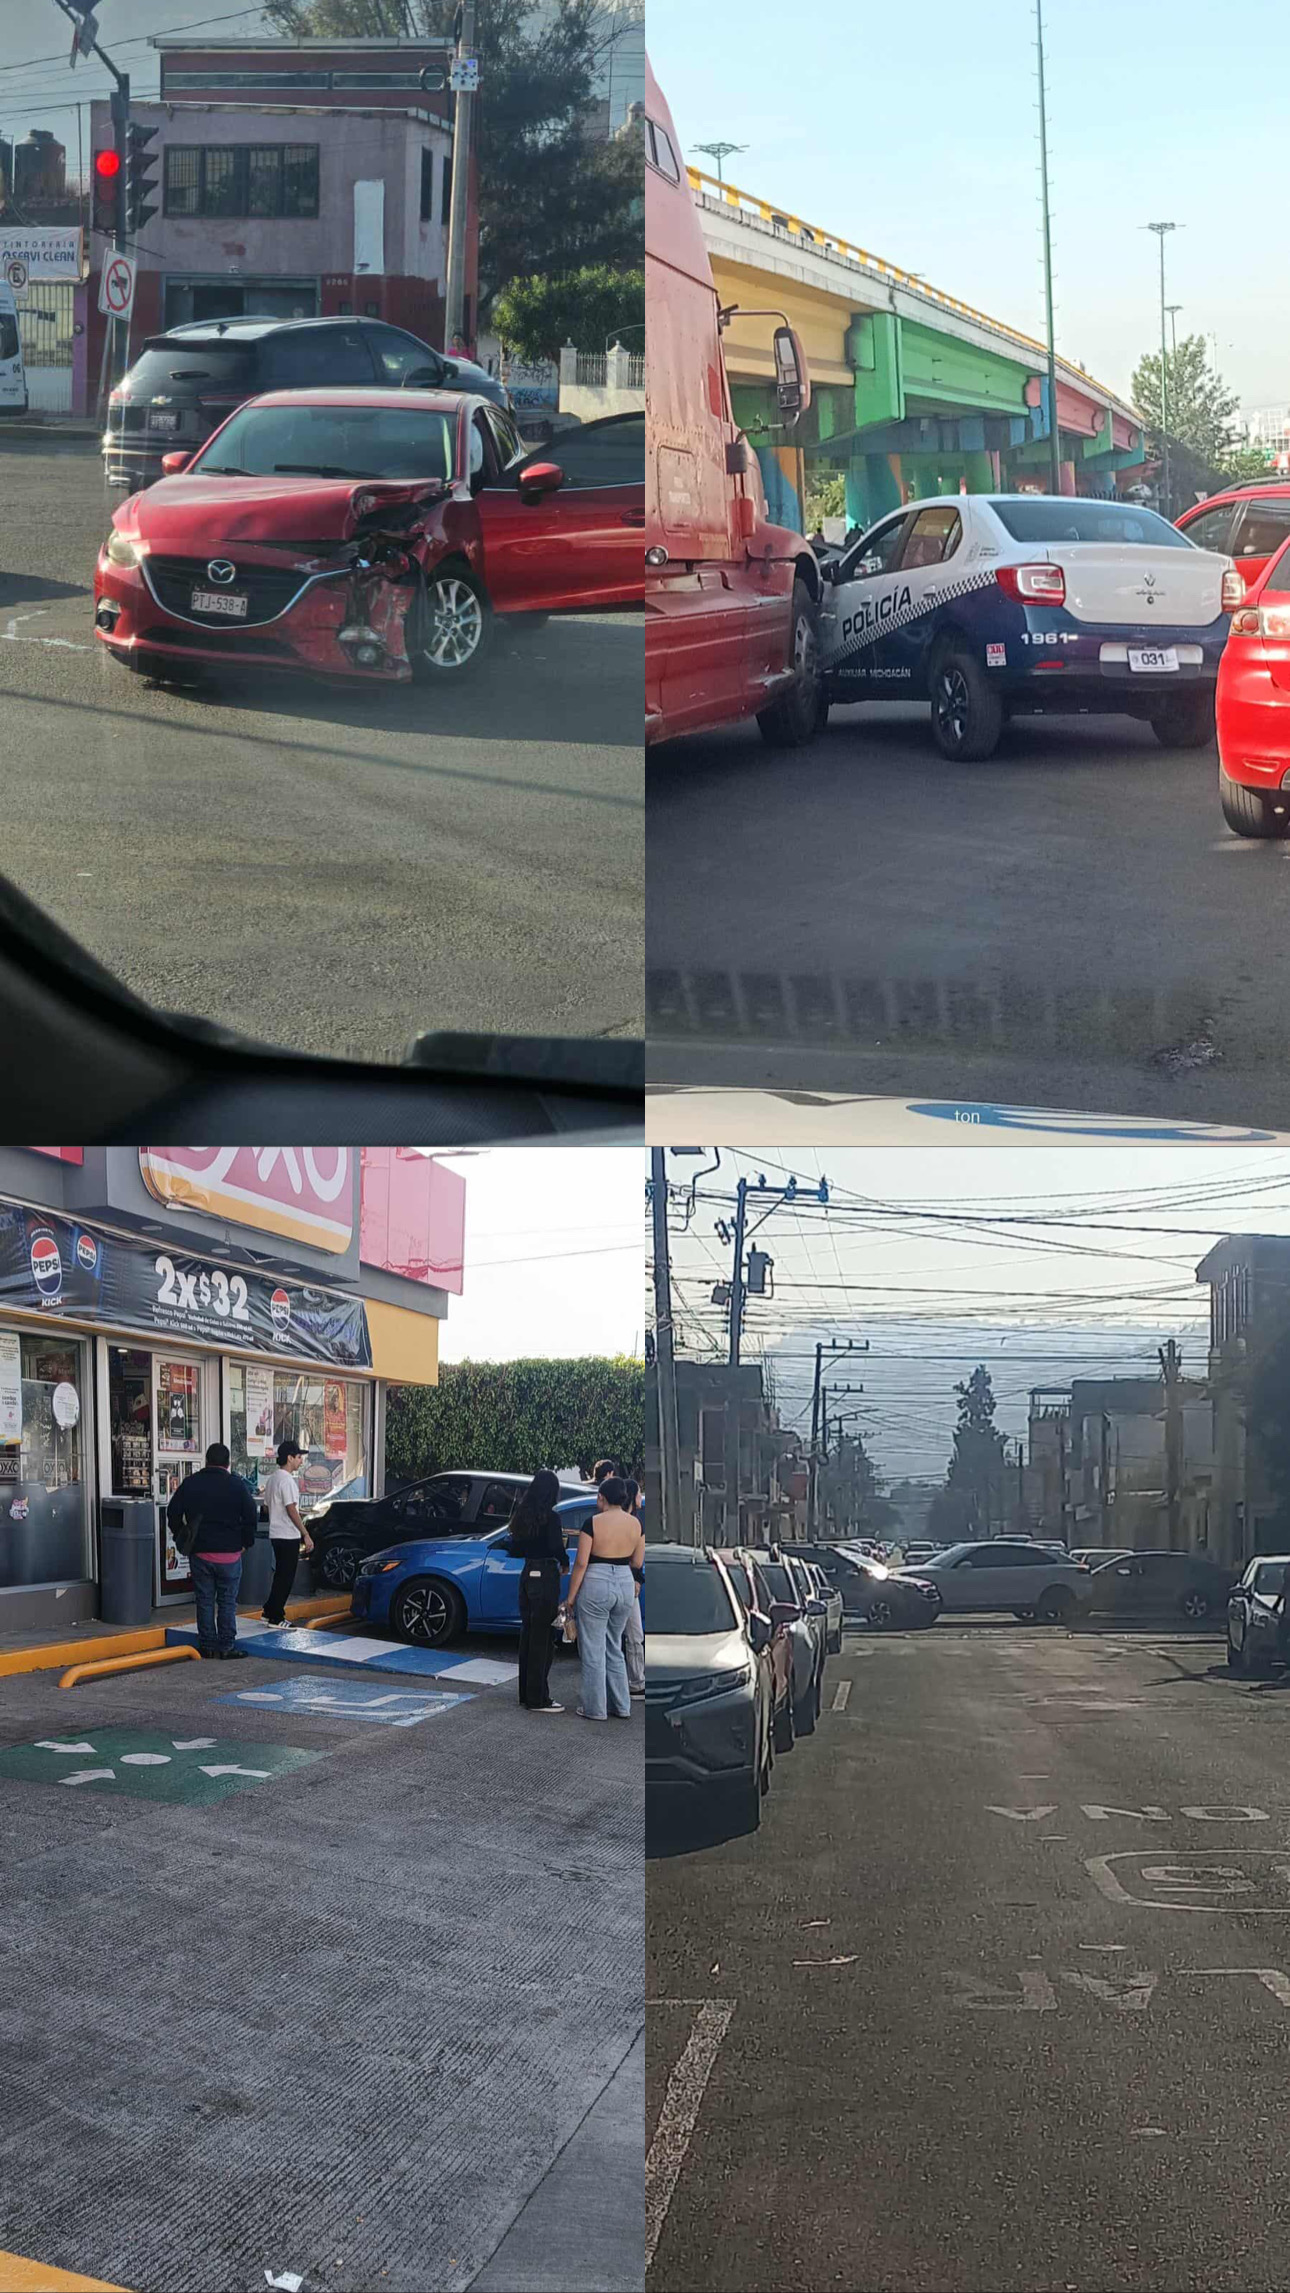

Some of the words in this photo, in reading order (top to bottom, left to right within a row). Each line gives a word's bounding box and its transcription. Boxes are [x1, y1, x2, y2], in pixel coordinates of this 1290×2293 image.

[842, 585, 912, 641] POLICÍA
[1141, 653, 1165, 665] 031
[41, 1296, 63, 1307] KICK
